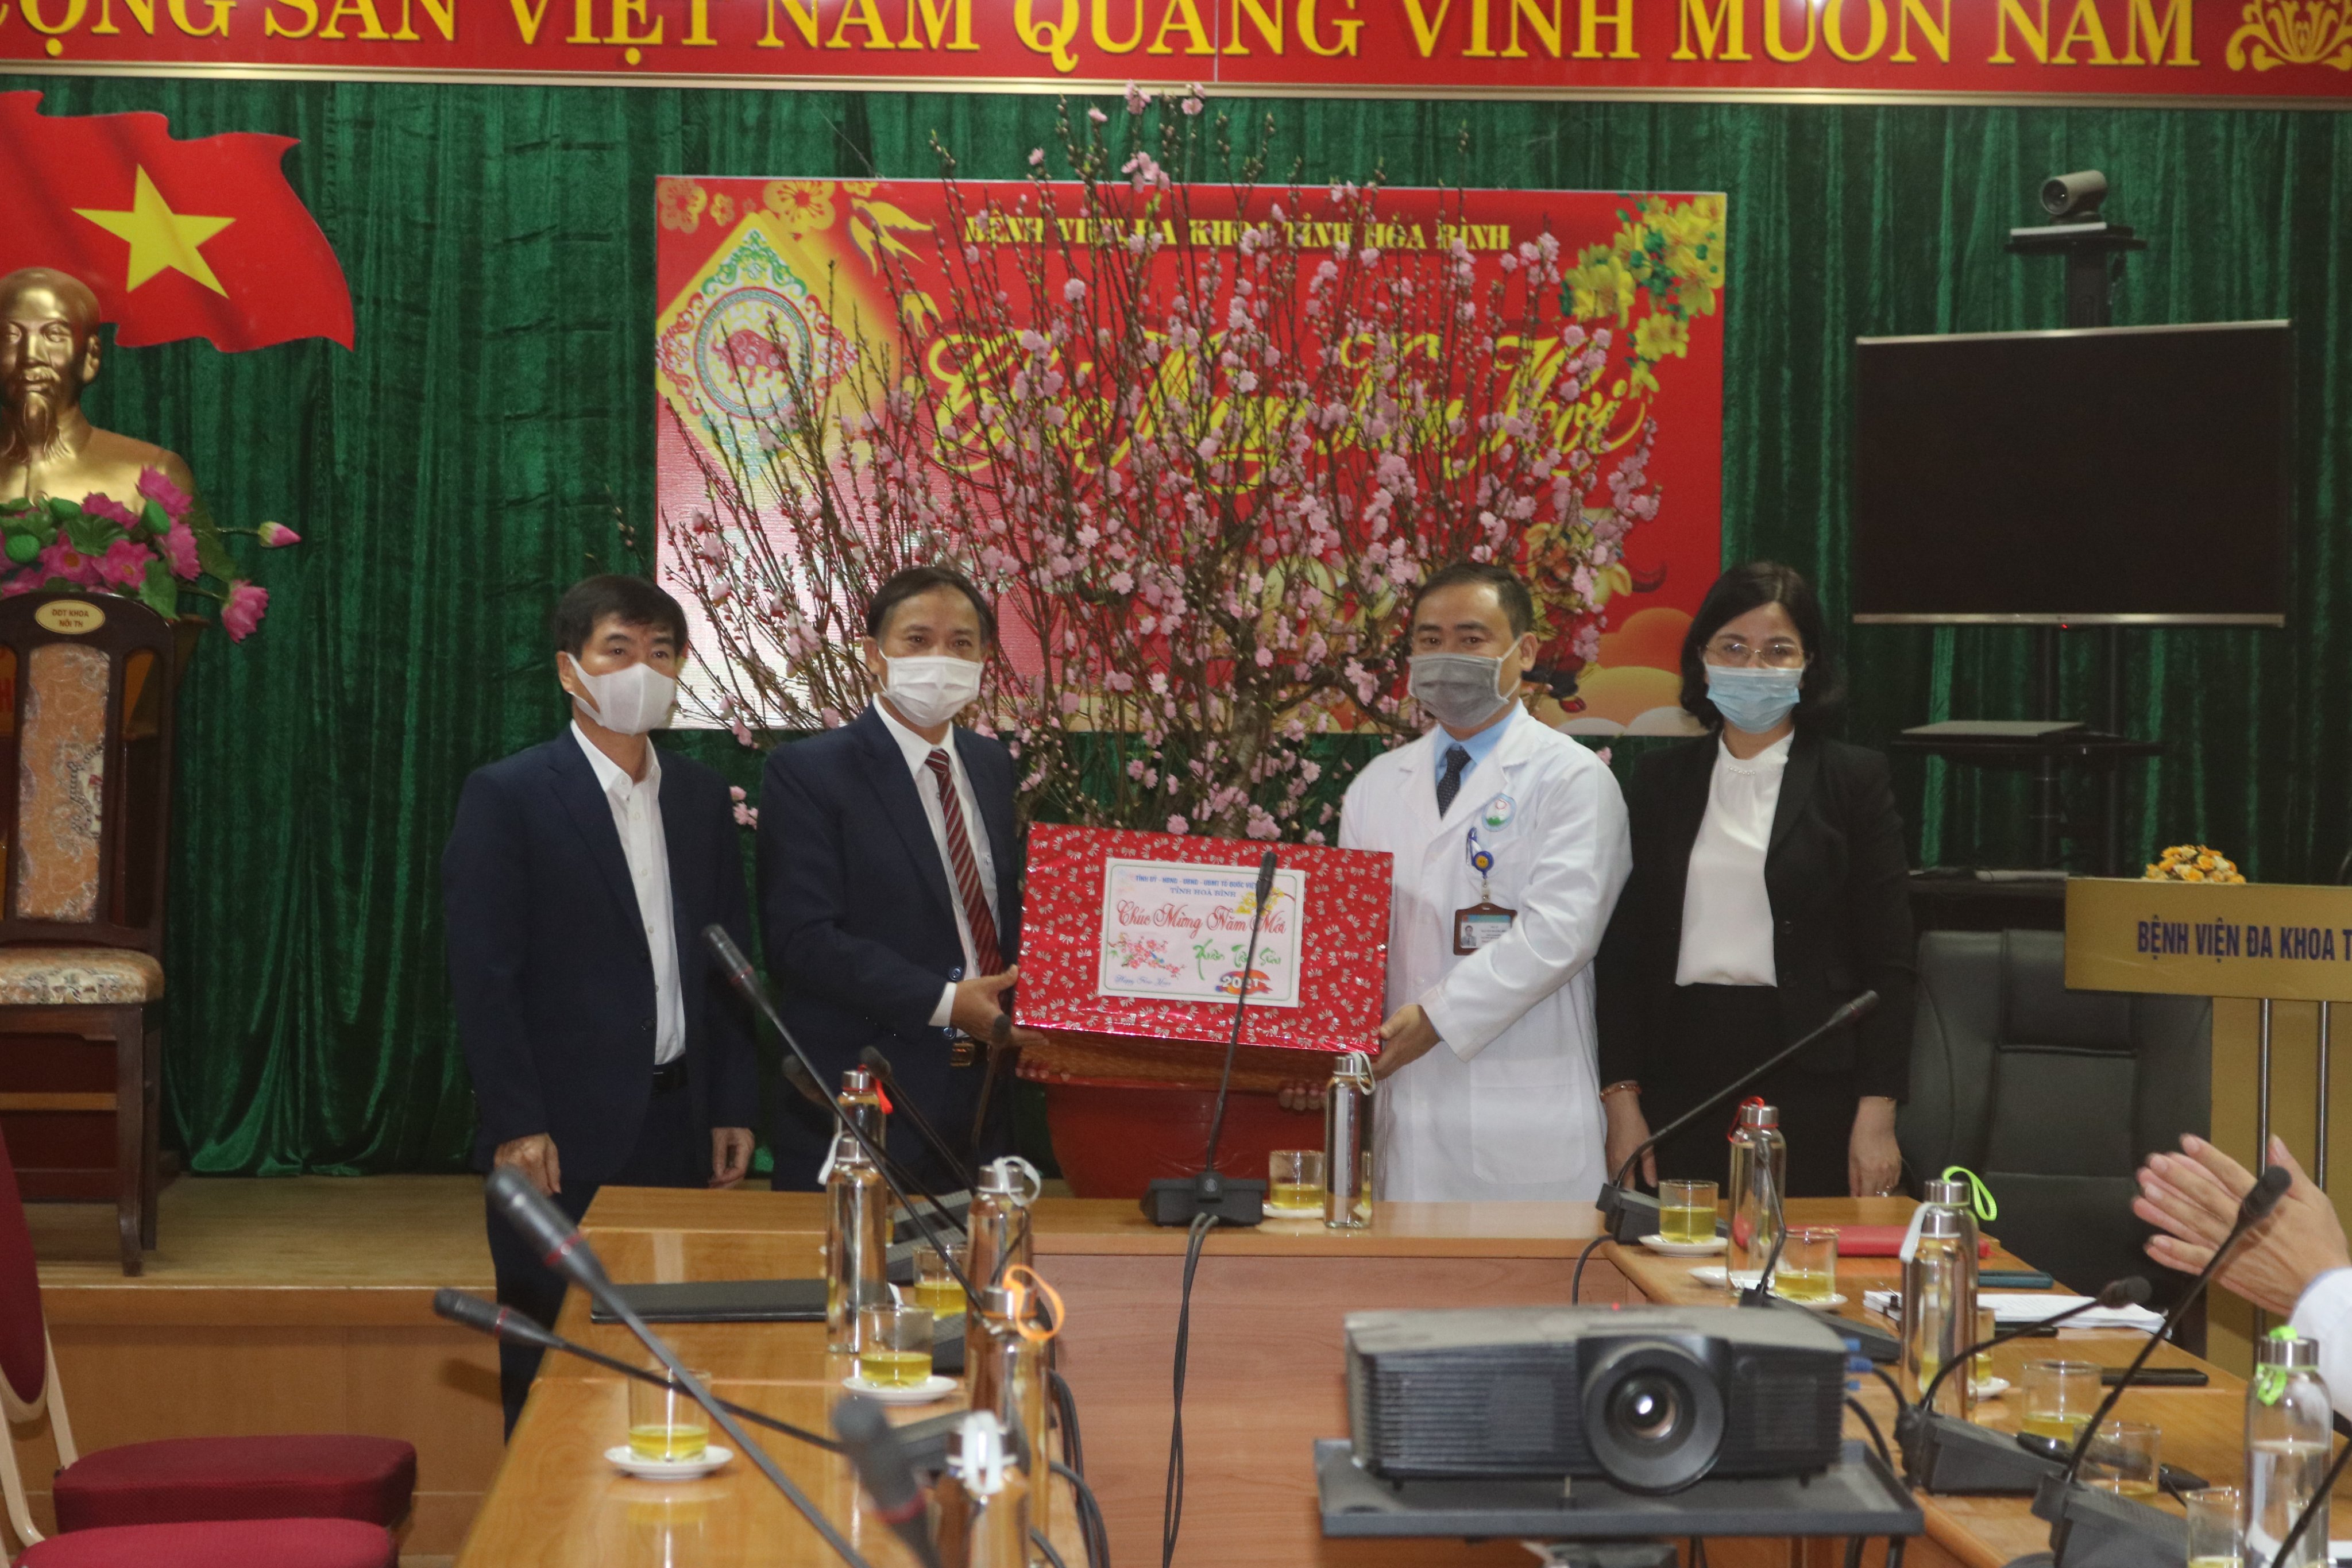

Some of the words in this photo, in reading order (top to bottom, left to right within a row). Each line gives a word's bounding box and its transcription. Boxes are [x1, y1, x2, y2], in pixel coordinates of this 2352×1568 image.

[757, 0, 980, 50] NAM
[1013, 0, 1365, 72] QUANG
[1399, 0, 1640, 59] VINH
[69, 609, 89, 617] KHOA
[1117, 900, 1149, 926] Chúc
[1153, 903, 1203, 939] Mừng
[1206, 905, 1247, 931] Năm
[1250, 909, 1286, 934] Mới
[2138, 914, 2189, 960] BỆNH
[2195, 917, 2241, 963] VIỆN
[2246, 925, 2273, 959] ĐA
[2280, 927, 2336, 961] KHOA
[1193, 939, 1225, 980] Xuân
[1231, 944, 1249, 968] Tâ
